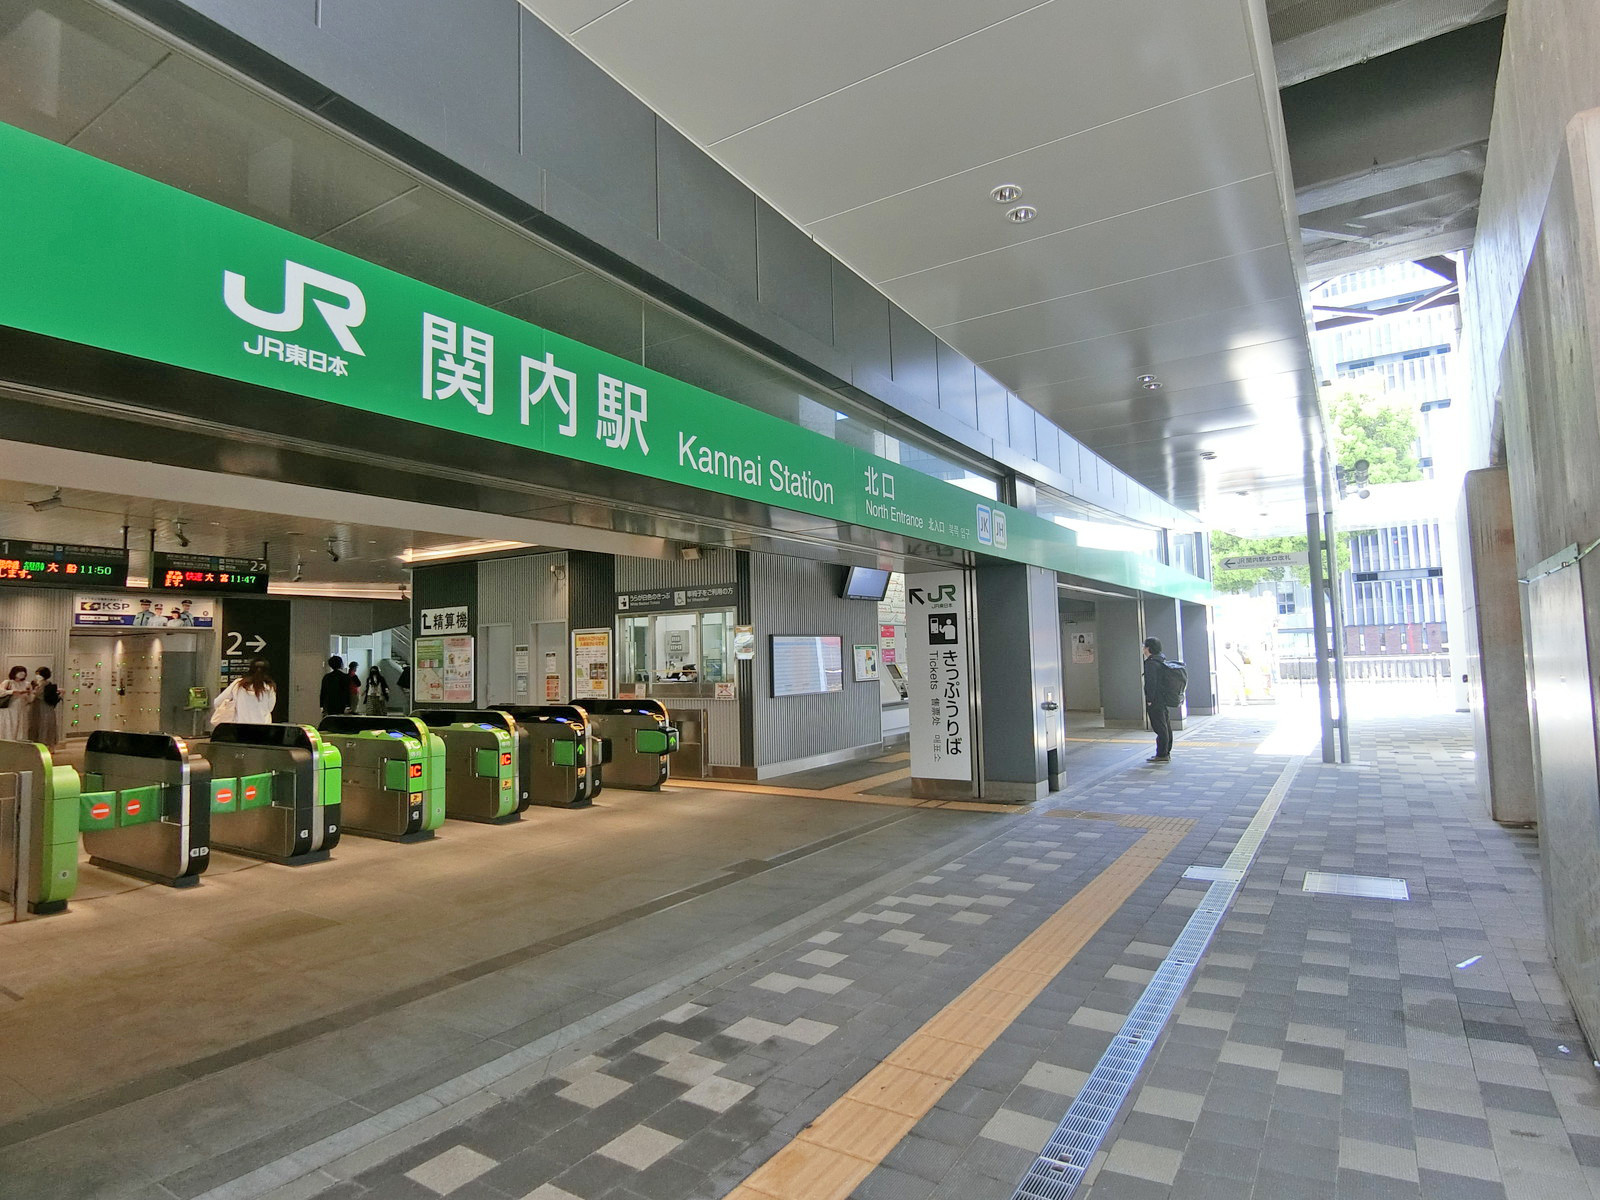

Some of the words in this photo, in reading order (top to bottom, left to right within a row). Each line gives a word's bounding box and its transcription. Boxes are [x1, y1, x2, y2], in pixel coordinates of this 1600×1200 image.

[224, 259, 366, 357] JR
[243, 335, 349, 377] JR東日本
[422, 311, 650, 457] 関内駅
[678, 431, 762, 487] Kannai
[768, 459, 835, 505] Station
[864, 465, 895, 501] 北口
[865, 499, 889, 520] North
[890, 506, 924, 529] Entrance
[980, 517, 989, 534] JK
[996, 522, 1004, 538] JH
[80, 564, 112, 575] 11:50
[249, 560, 259, 572] 2
[230, 574, 257, 584] 11:47
[927, 584, 957, 603] JR
[102, 602, 130, 611] KSP
[432, 611, 468, 631] 精算機
[226, 631, 243, 656] 2
[929, 650, 939, 690] Tickets
[410, 764, 422, 778] IC
